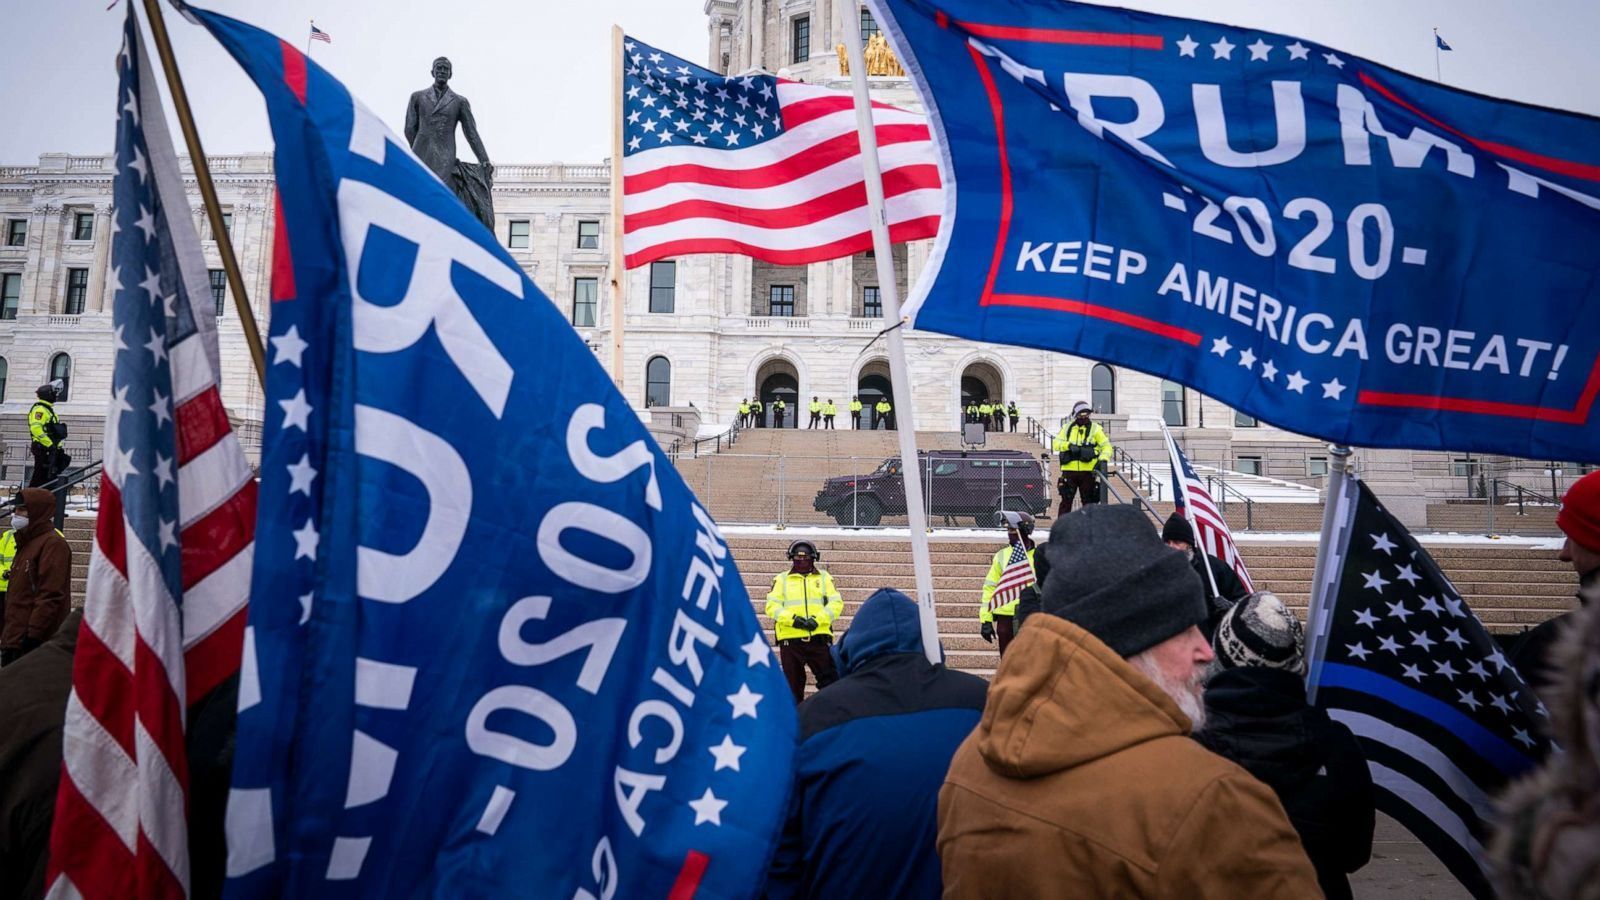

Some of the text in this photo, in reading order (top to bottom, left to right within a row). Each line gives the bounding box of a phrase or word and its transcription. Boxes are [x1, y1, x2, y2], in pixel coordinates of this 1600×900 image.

[1015, 241, 1570, 382] KEEP AMERICA GREAT!
